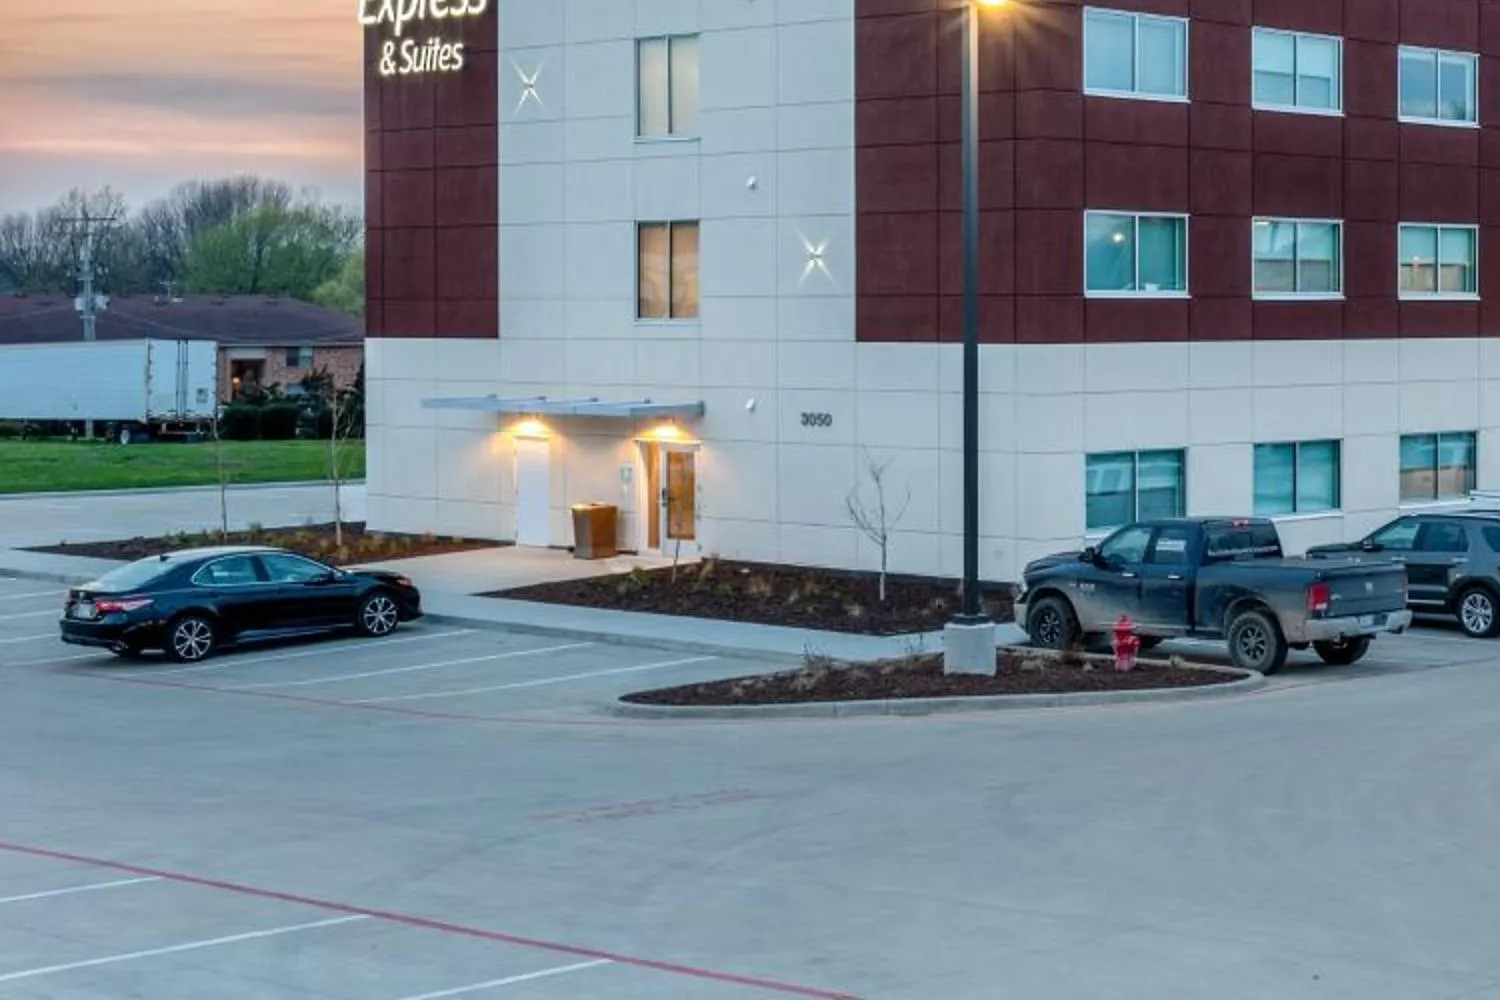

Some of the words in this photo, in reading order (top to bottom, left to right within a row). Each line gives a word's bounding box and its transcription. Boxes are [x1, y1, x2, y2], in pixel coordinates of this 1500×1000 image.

[379, 39, 396, 75] &
[398, 36, 464, 75] Suites
[800, 411, 833, 427] 3050
